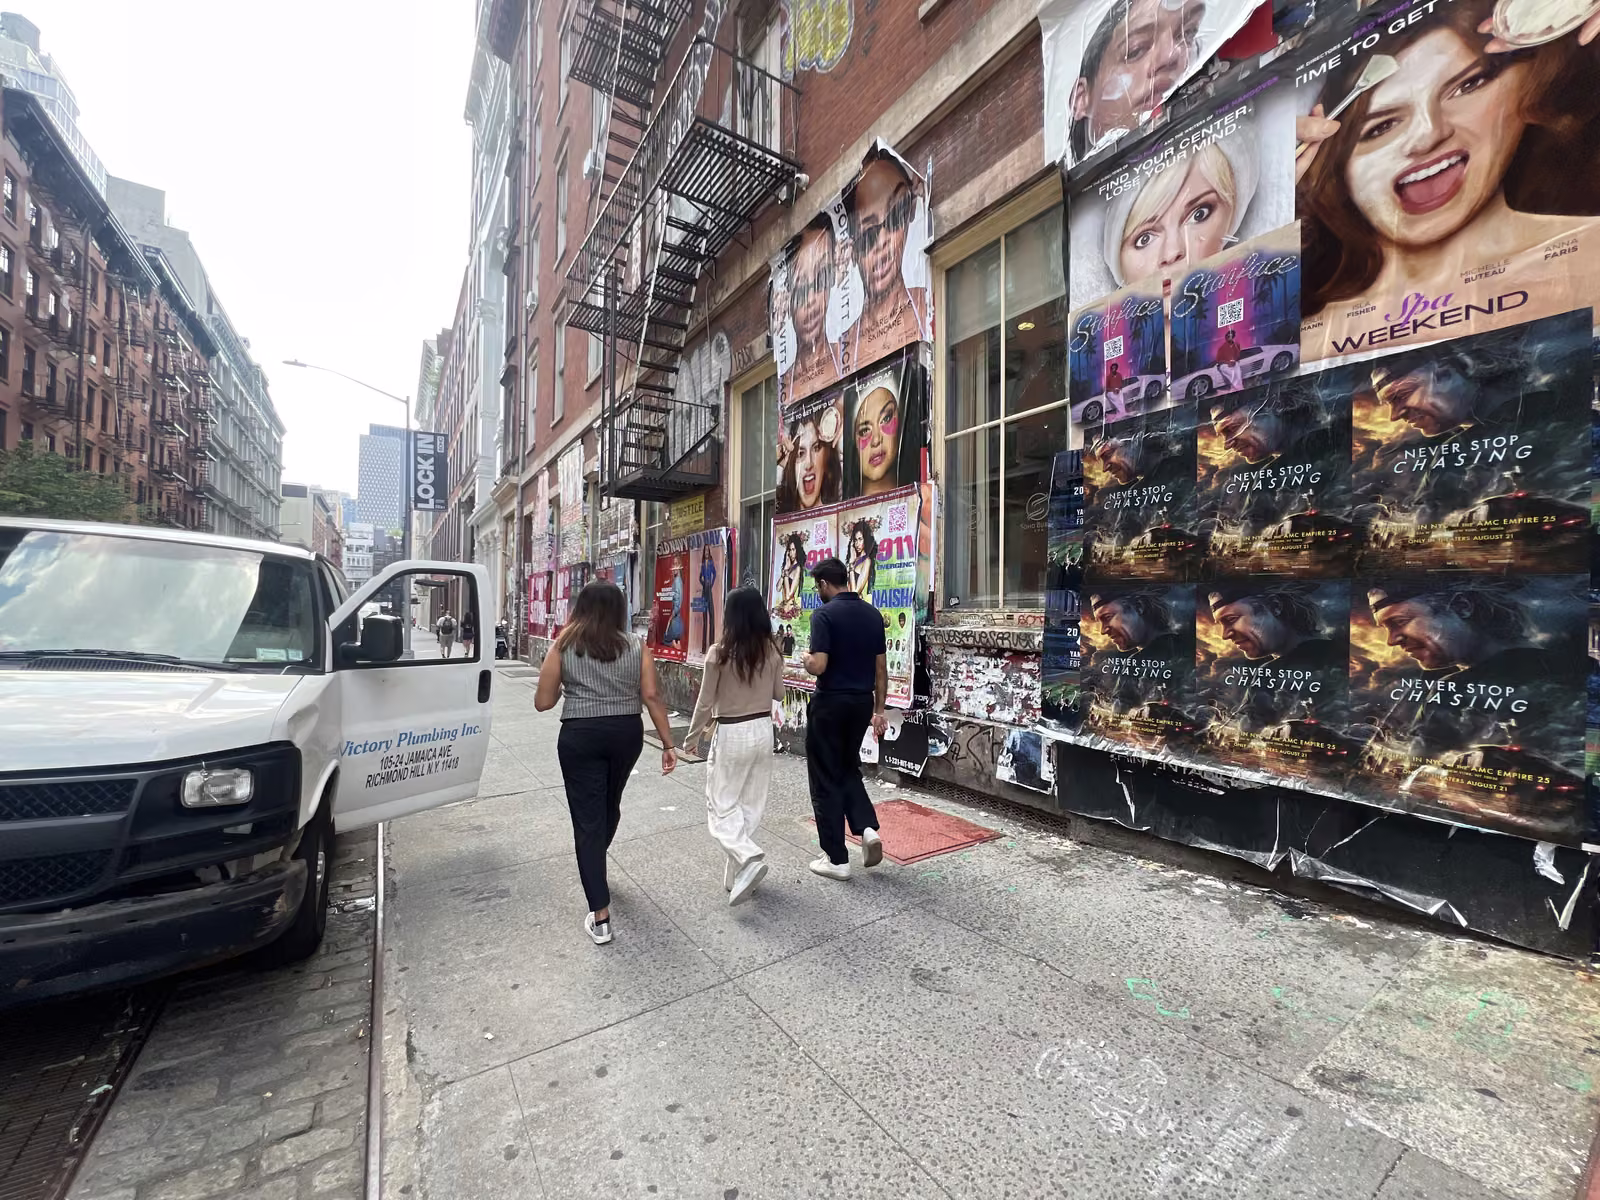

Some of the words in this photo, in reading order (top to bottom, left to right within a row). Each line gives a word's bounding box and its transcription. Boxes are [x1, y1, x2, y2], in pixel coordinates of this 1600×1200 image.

[1348, 33, 1380, 57] TO
[1388, 0, 1438, 35] GET
[1098, 172, 1130, 196] FIND
[1133, 146, 1174, 173] YOUR
[1179, 105, 1253, 150] CENTER.
[1106, 178, 1141, 202] LOSE
[1145, 151, 1187, 178] YOUR
[1192, 122, 1243, 154] MIND.
[1544, 238, 1579, 253] ANNA
[1544, 245, 1579, 261] FARIS
[1460, 258, 1511, 277] MICHELLE
[1464, 267, 1506, 284] BUTEAU
[1346, 305, 1377, 318] FISHER
[1352, 301, 1371, 311] ISLA
[1384, 291, 1455, 328] Spa
[1300, 321, 1324, 333] MANN
[1331, 290, 1529, 353] WEEKEND
[417, 433, 435, 455] IN
[1404, 442, 1460, 460] NEVER
[1471, 435, 1519, 451] STOP
[1394, 445, 1533, 474] CHASING
[1233, 469, 1273, 482] NEVER
[1279, 463, 1312, 476] STOP
[417, 456, 435, 509] LOCK
[1226, 472, 1321, 494] CHASING
[1109, 487, 1138, 500] NEVER
[1142, 484, 1166, 497] STOP
[1103, 492, 1173, 511] CHASING
[1477, 519, 1500, 527] AMC
[1503, 517, 1539, 525] EMPIRE
[1543, 515, 1556, 523] 25
[1302, 530, 1326, 538] EMPIRE
[1328, 529, 1337, 537] 25
[1408, 537, 1425, 545] ONLY
[1473, 533, 1503, 541] AUGUST
[670, 537, 689, 554] NAVY
[876, 534, 915, 561] 911
[1101, 665, 1172, 679] CHASING
[1107, 657, 1137, 667] NEVER
[1141, 659, 1166, 669] STOP
[1232, 666, 1272, 677] NEVER
[1278, 669, 1312, 680] STOP
[1224, 675, 1322, 693] CHASING
[1401, 677, 1456, 692] NEVER
[1467, 683, 1515, 698] STOP
[1390, 688, 1529, 713] CHASING
[341, 738, 393, 757] Victory
[396, 727, 458, 748] Plumbing
[461, 723, 482, 737] Inc.
[1300, 739, 1325, 749] EMPIRE
[380, 754, 404, 771] 105-24
[404, 748, 438, 766] JAMAICA
[438, 745, 453, 758] AVE.
[1280, 749, 1300, 757] AUGUST
[365, 768, 409, 789] RICHMOND
[409, 763, 425, 780] HILL
[426, 761, 439, 775] N.Y.
[441, 757, 460, 771] 11418
[1471, 766, 1494, 775] AMC
[1497, 769, 1533, 782] EMPIRE
[1537, 776, 1551, 784] 25
[1466, 779, 1497, 791] AUGUST
